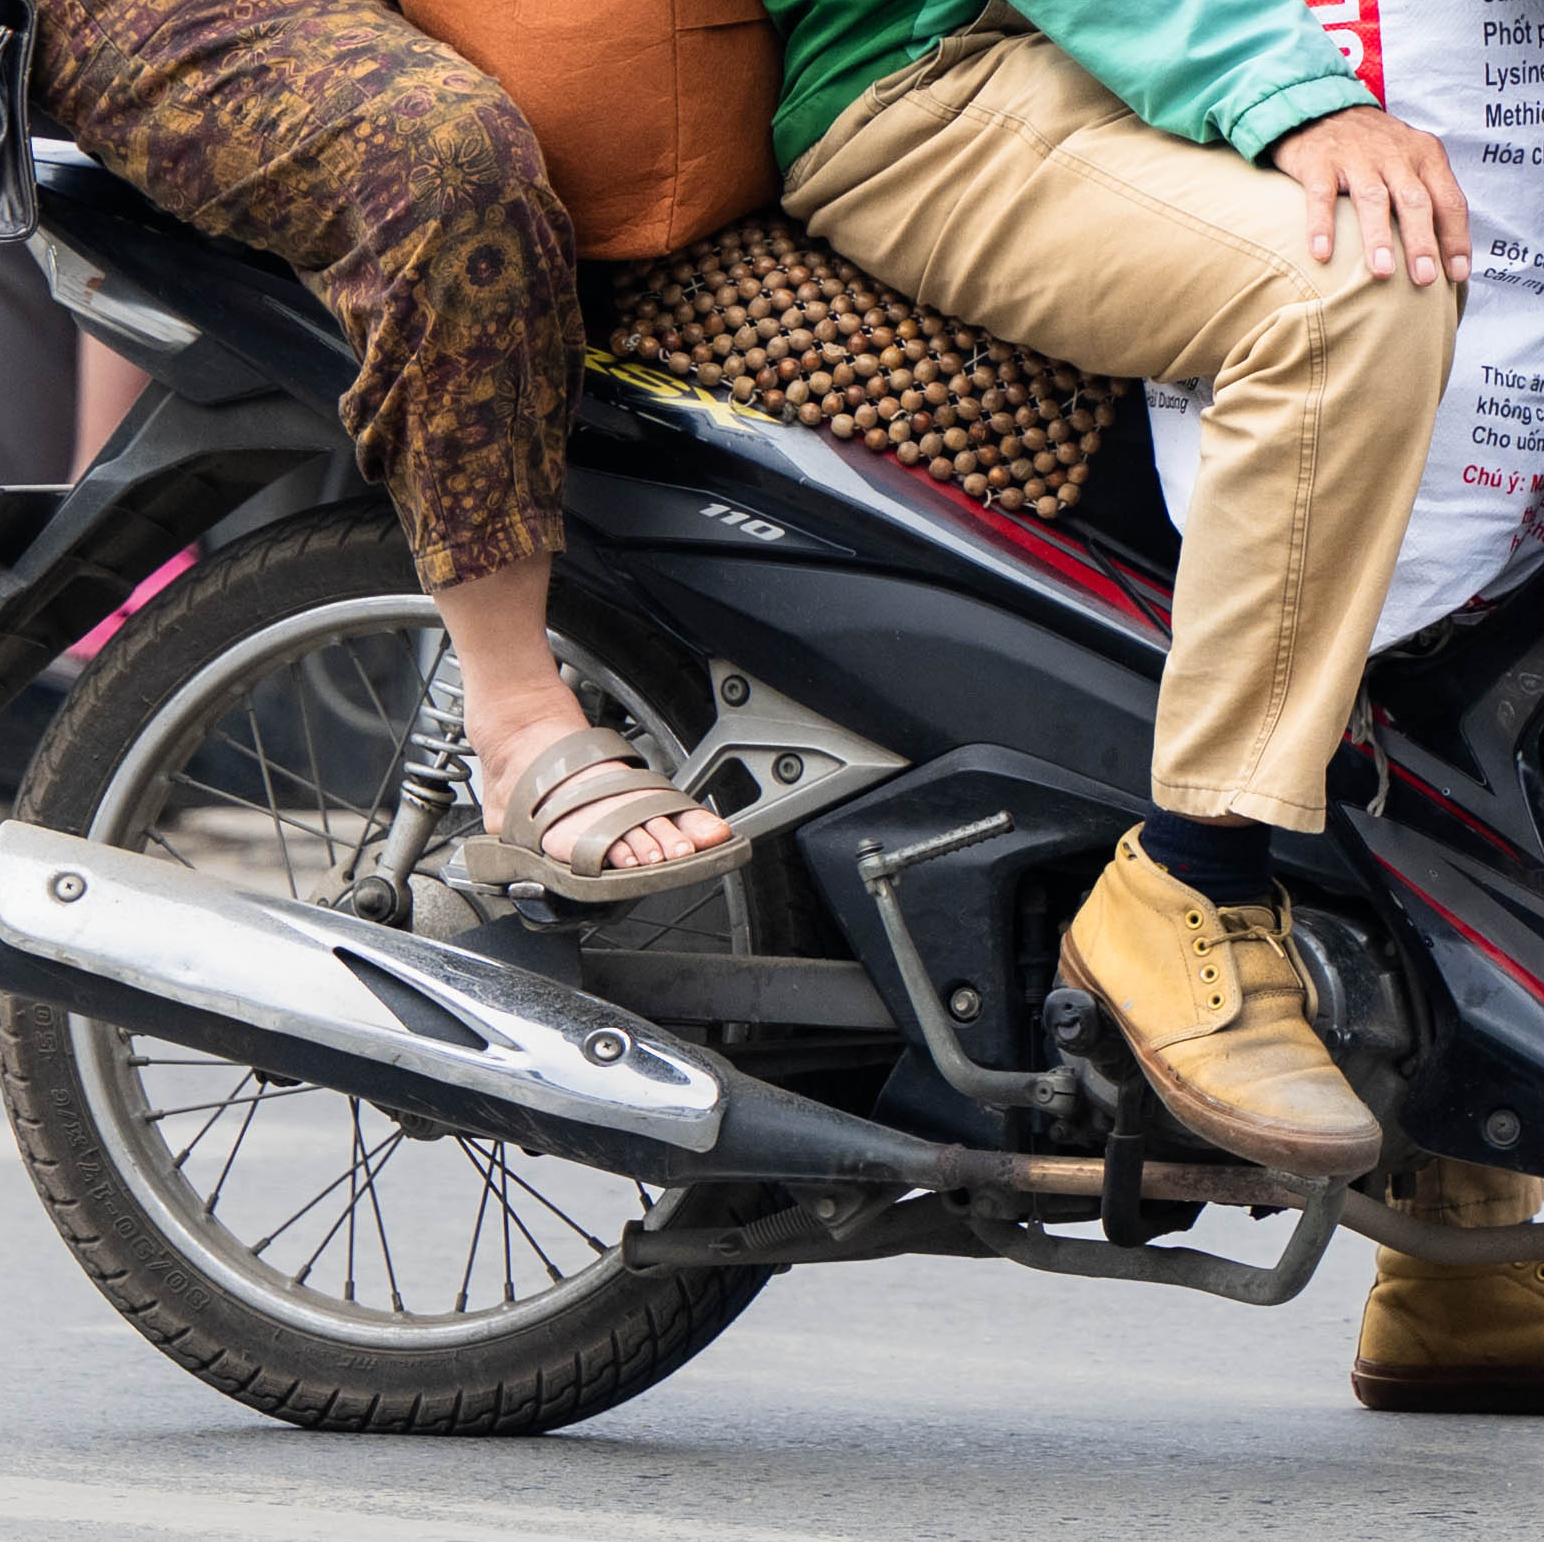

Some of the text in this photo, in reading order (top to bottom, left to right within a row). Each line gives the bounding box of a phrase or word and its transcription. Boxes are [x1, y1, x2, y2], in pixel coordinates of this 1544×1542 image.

[1483, 14, 1532, 46] Phốt
[1482, 142, 1525, 165] Hóa
[1489, 239, 1529, 266] Bột
[1481, 364, 1527, 391] Thức
[1476, 395, 1532, 425] không
[1472, 425, 1511, 449] Cho
[1462, 464, 1503, 488] Chú
[1506, 470, 1526, 495] ý:
[698, 502, 786, 543] 110
